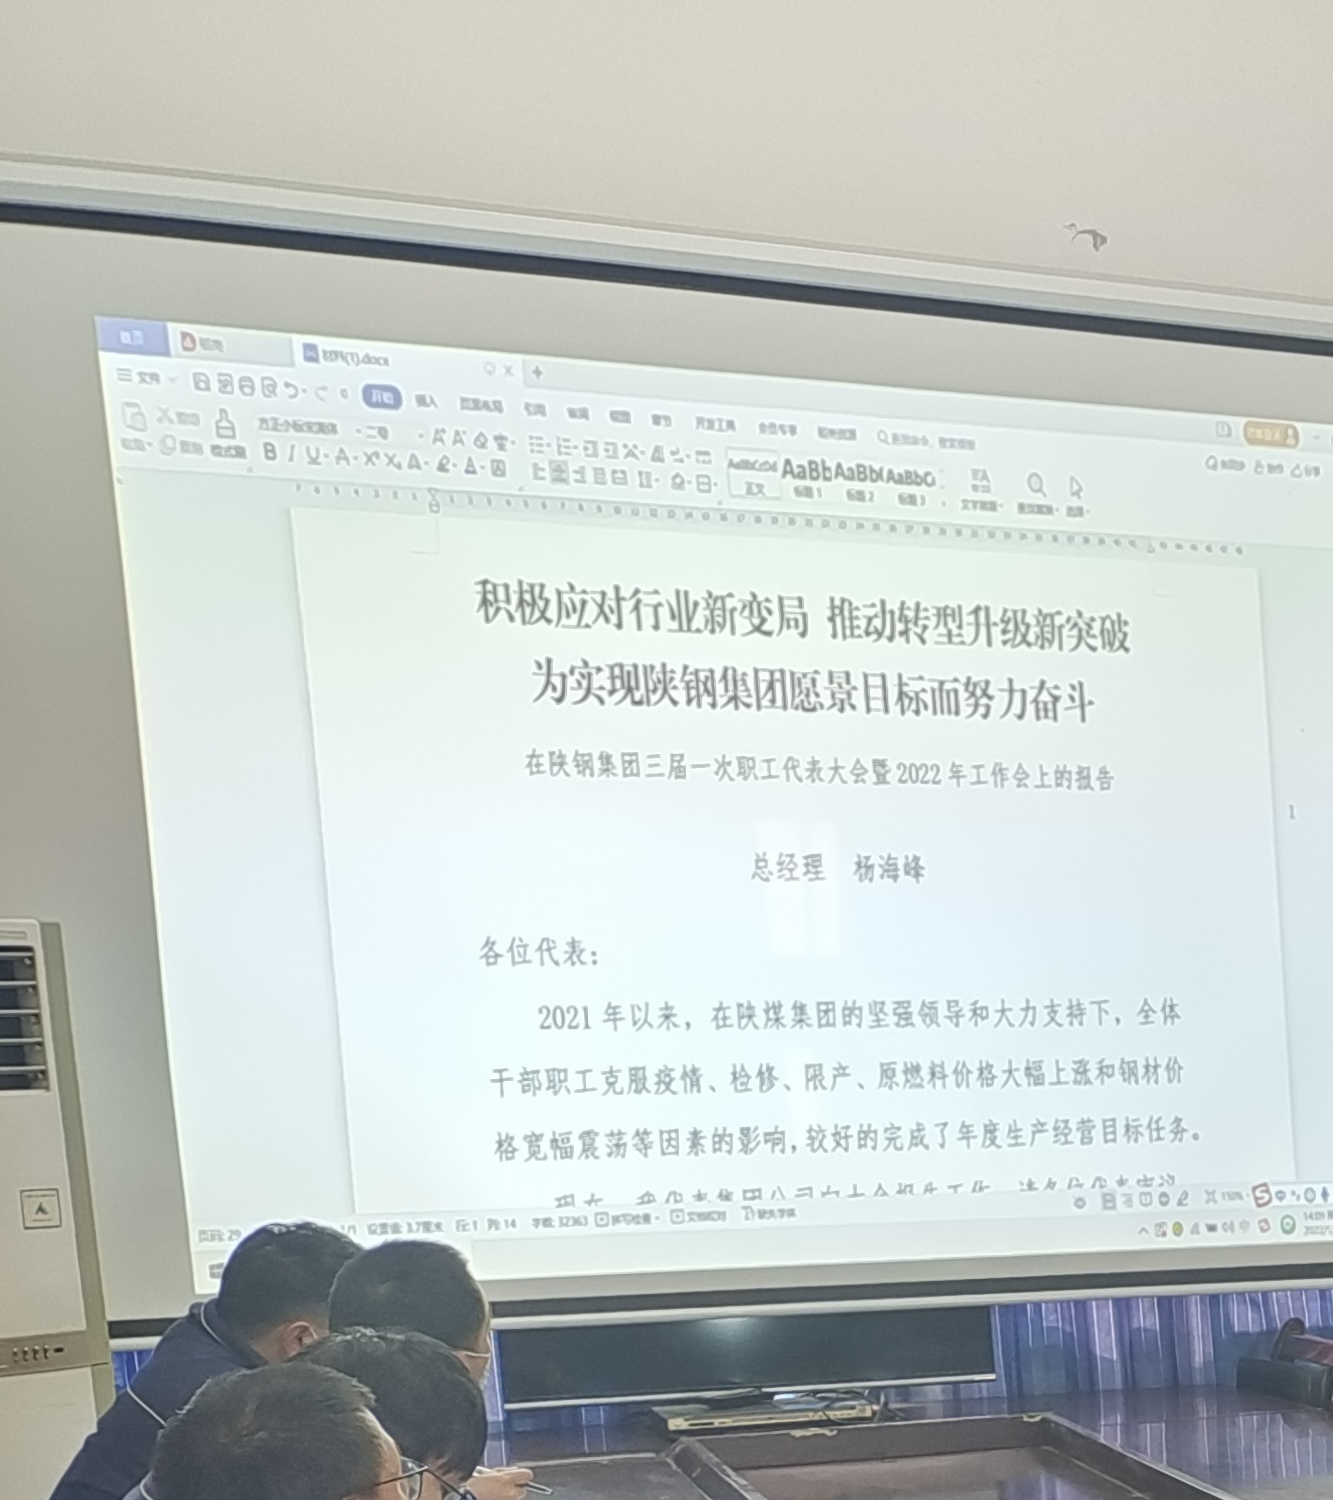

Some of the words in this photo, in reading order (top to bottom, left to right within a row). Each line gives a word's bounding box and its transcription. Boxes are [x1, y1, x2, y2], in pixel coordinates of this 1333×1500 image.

[473, 576, 809, 639] 积极应对行业新变局
[827, 594, 1131, 655] 推动转型升级新突破
[532, 656, 1095, 725] 为实现陕钢集团愿景目标而努力奋斗
[750, 852, 826, 884] 总经理
[853, 852, 927, 886] 杨海峰
